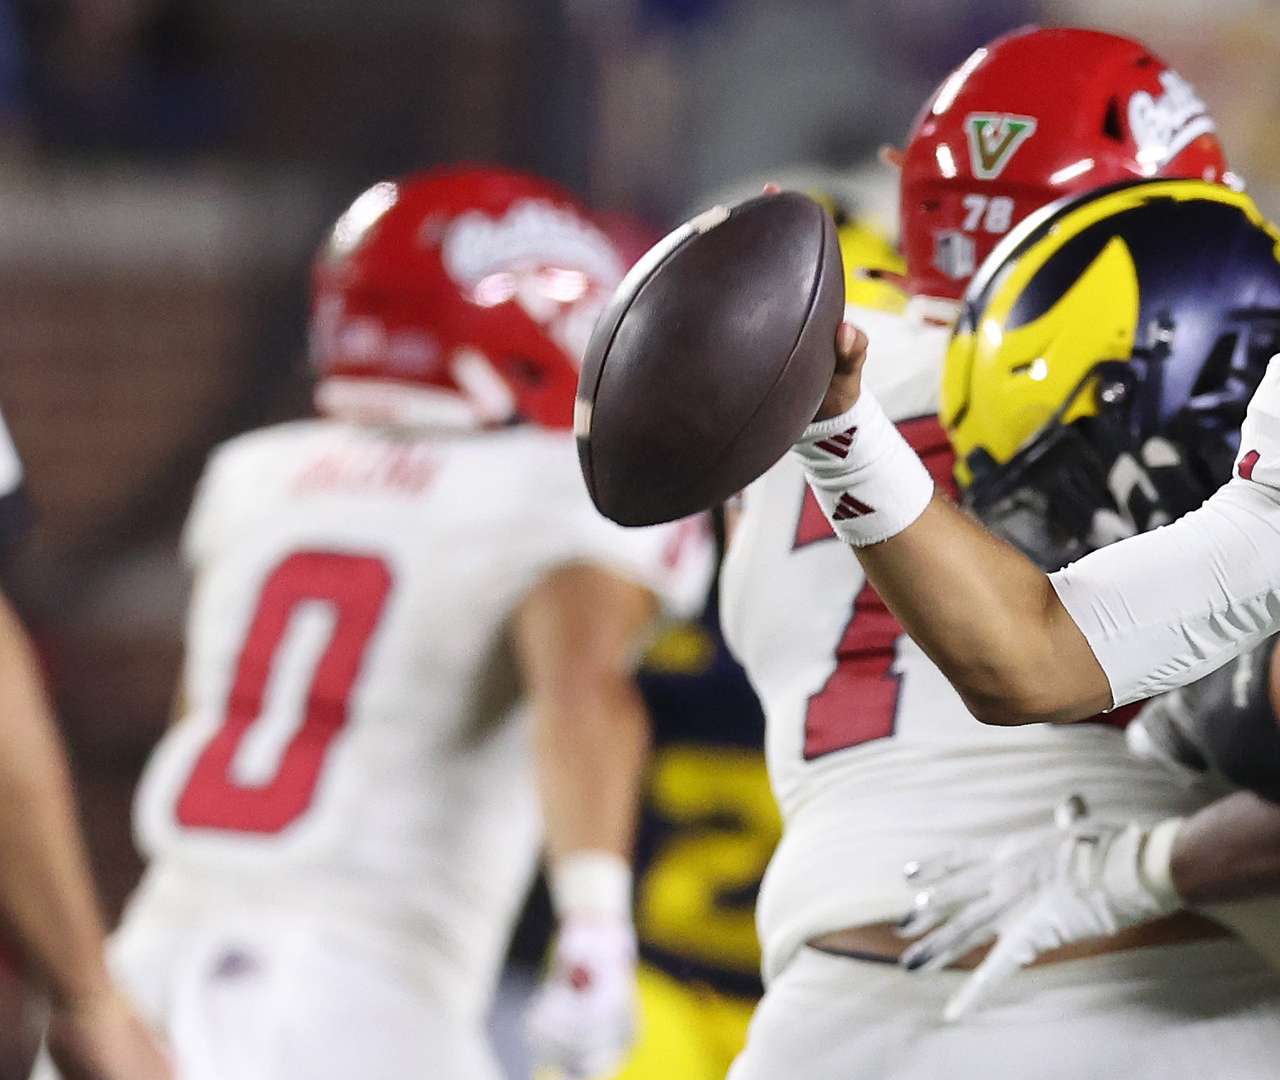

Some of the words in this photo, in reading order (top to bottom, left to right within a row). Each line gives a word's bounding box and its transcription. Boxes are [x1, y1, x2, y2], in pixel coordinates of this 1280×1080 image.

[965, 111, 1037, 180] V
[961, 193, 1014, 232] 78
[174, 548, 395, 836] 0
